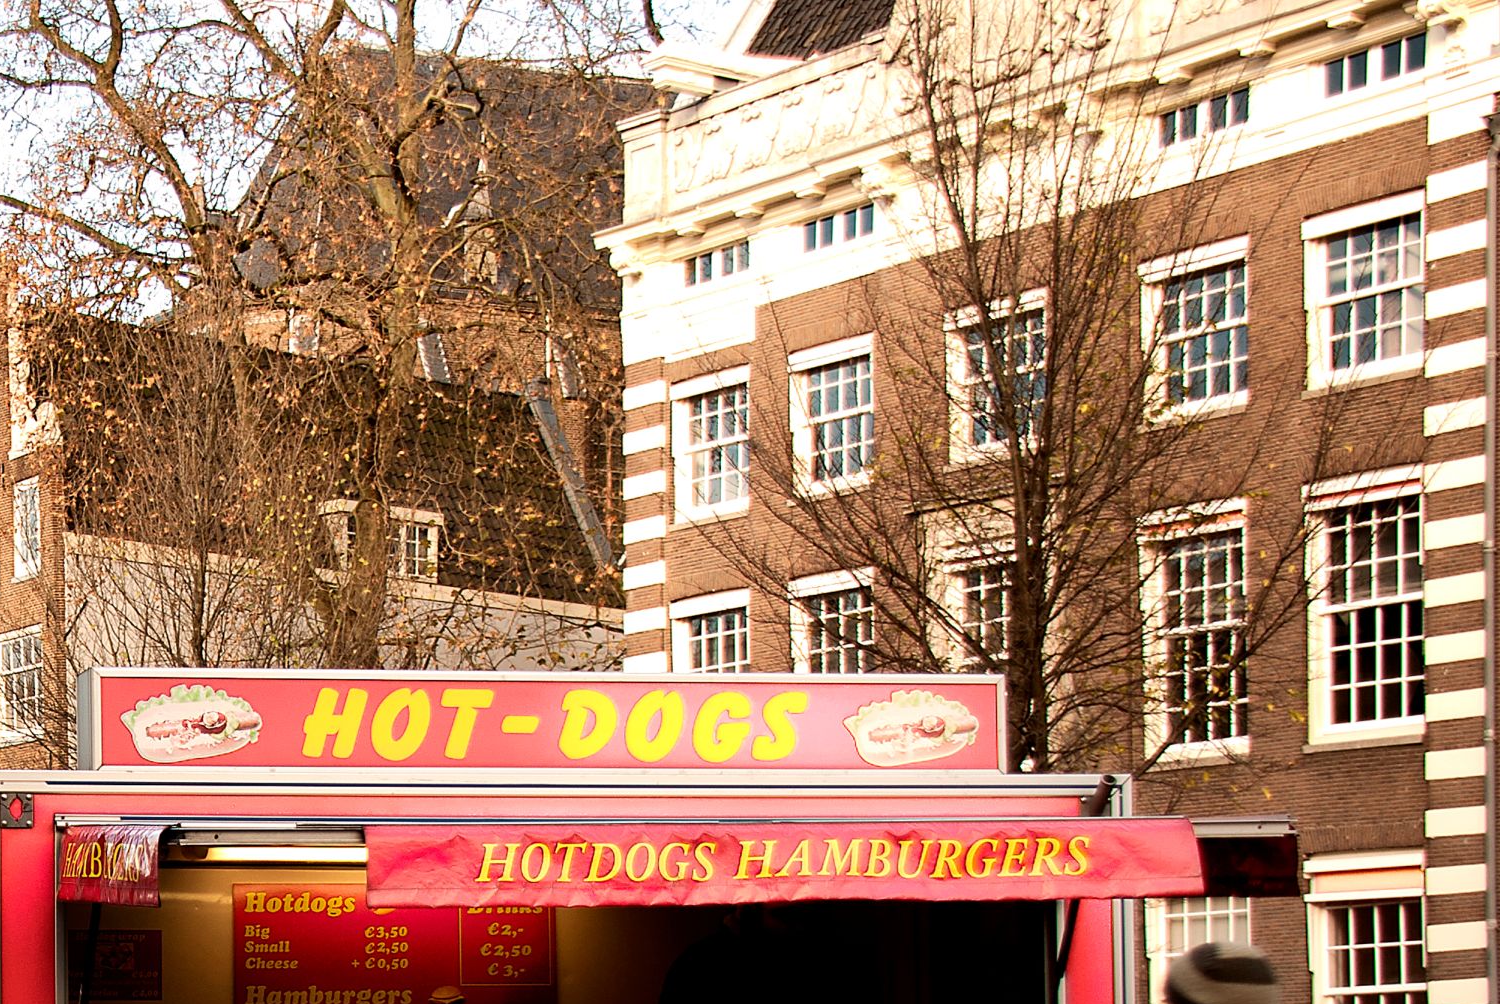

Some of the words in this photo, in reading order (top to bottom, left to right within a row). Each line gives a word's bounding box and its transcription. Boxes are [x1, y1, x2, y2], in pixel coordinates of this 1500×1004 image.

[475, 842, 717, 884] HOTDOGS
[733, 835, 1092, 880] HAMBURGERS
[244, 891, 357, 917] Hotdogs
[244, 924, 270, 939] Big
[364, 925, 409, 939] €3,50
[244, 940, 291, 954] Small
[364, 940, 409, 955] €2,50
[244, 957, 298, 970] Cheese
